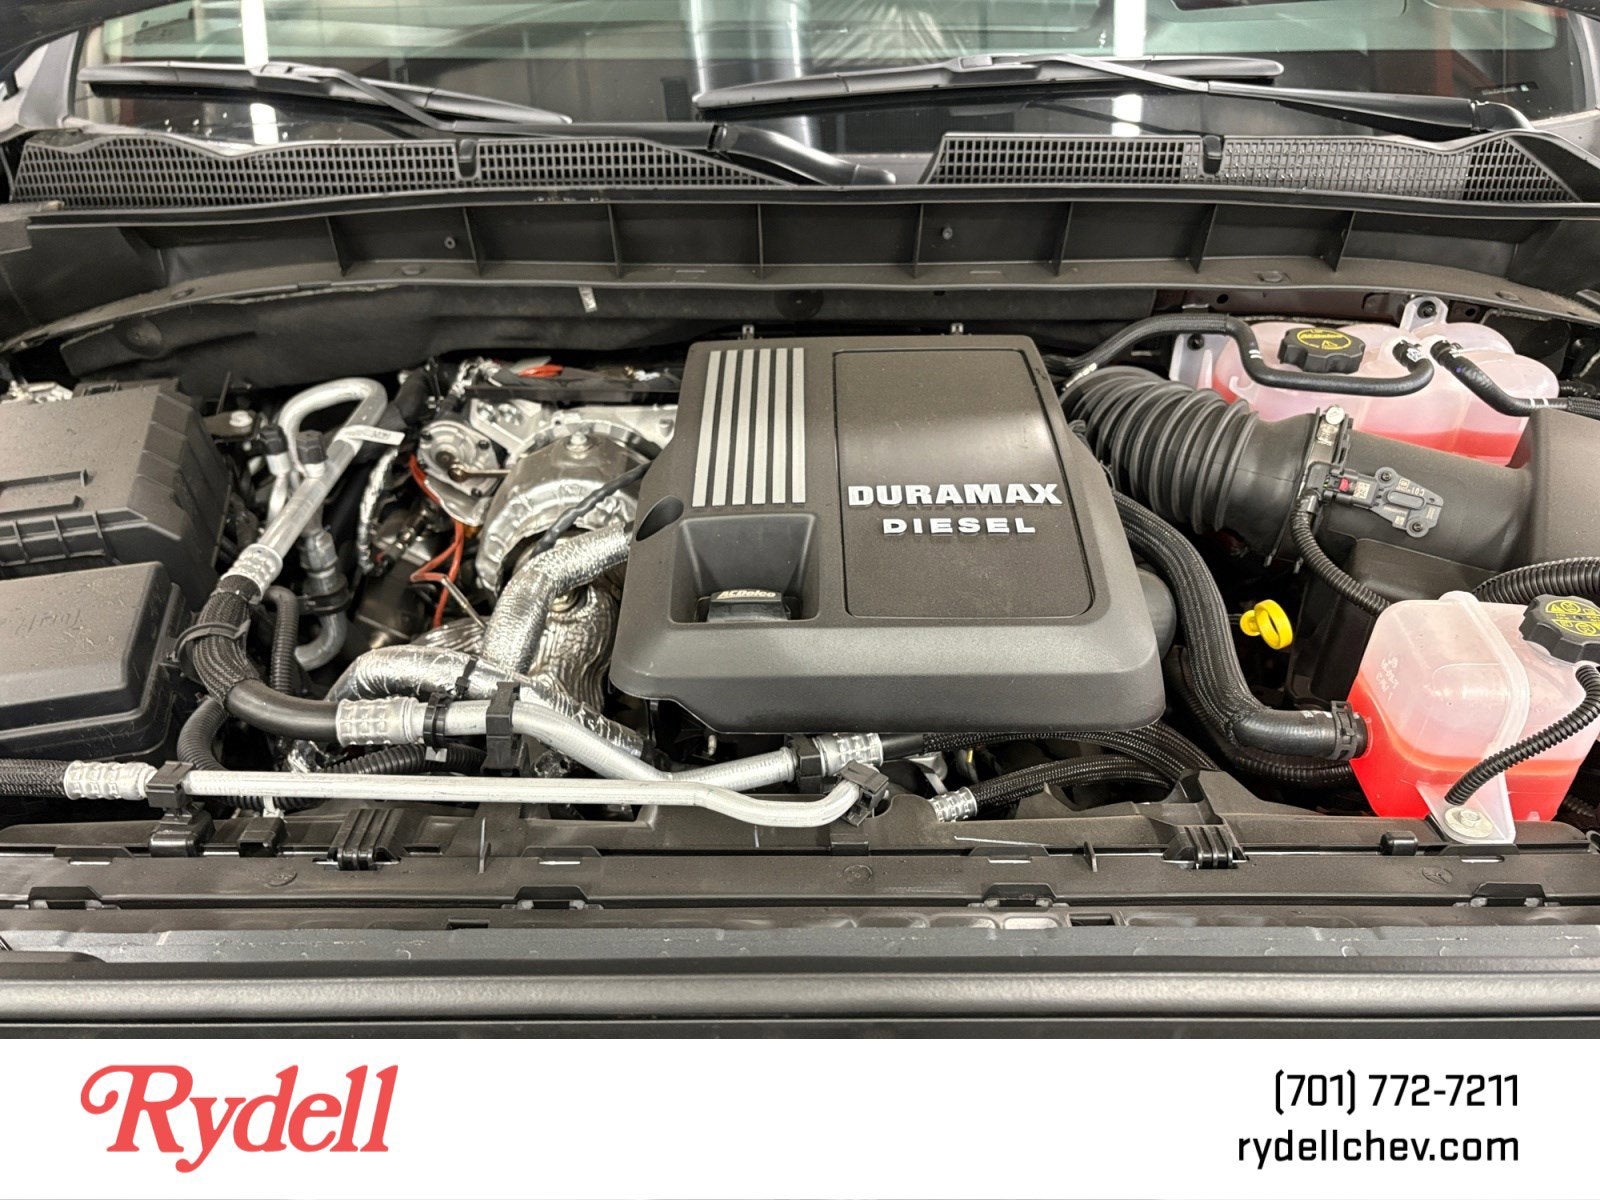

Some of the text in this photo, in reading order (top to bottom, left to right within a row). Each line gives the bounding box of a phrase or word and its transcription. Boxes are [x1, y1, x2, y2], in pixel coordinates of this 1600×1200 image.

[848, 484, 1062, 506] DURAMAX
[883, 517, 1036, 534] DIESEL
[717, 589, 776, 599] ACDelco
